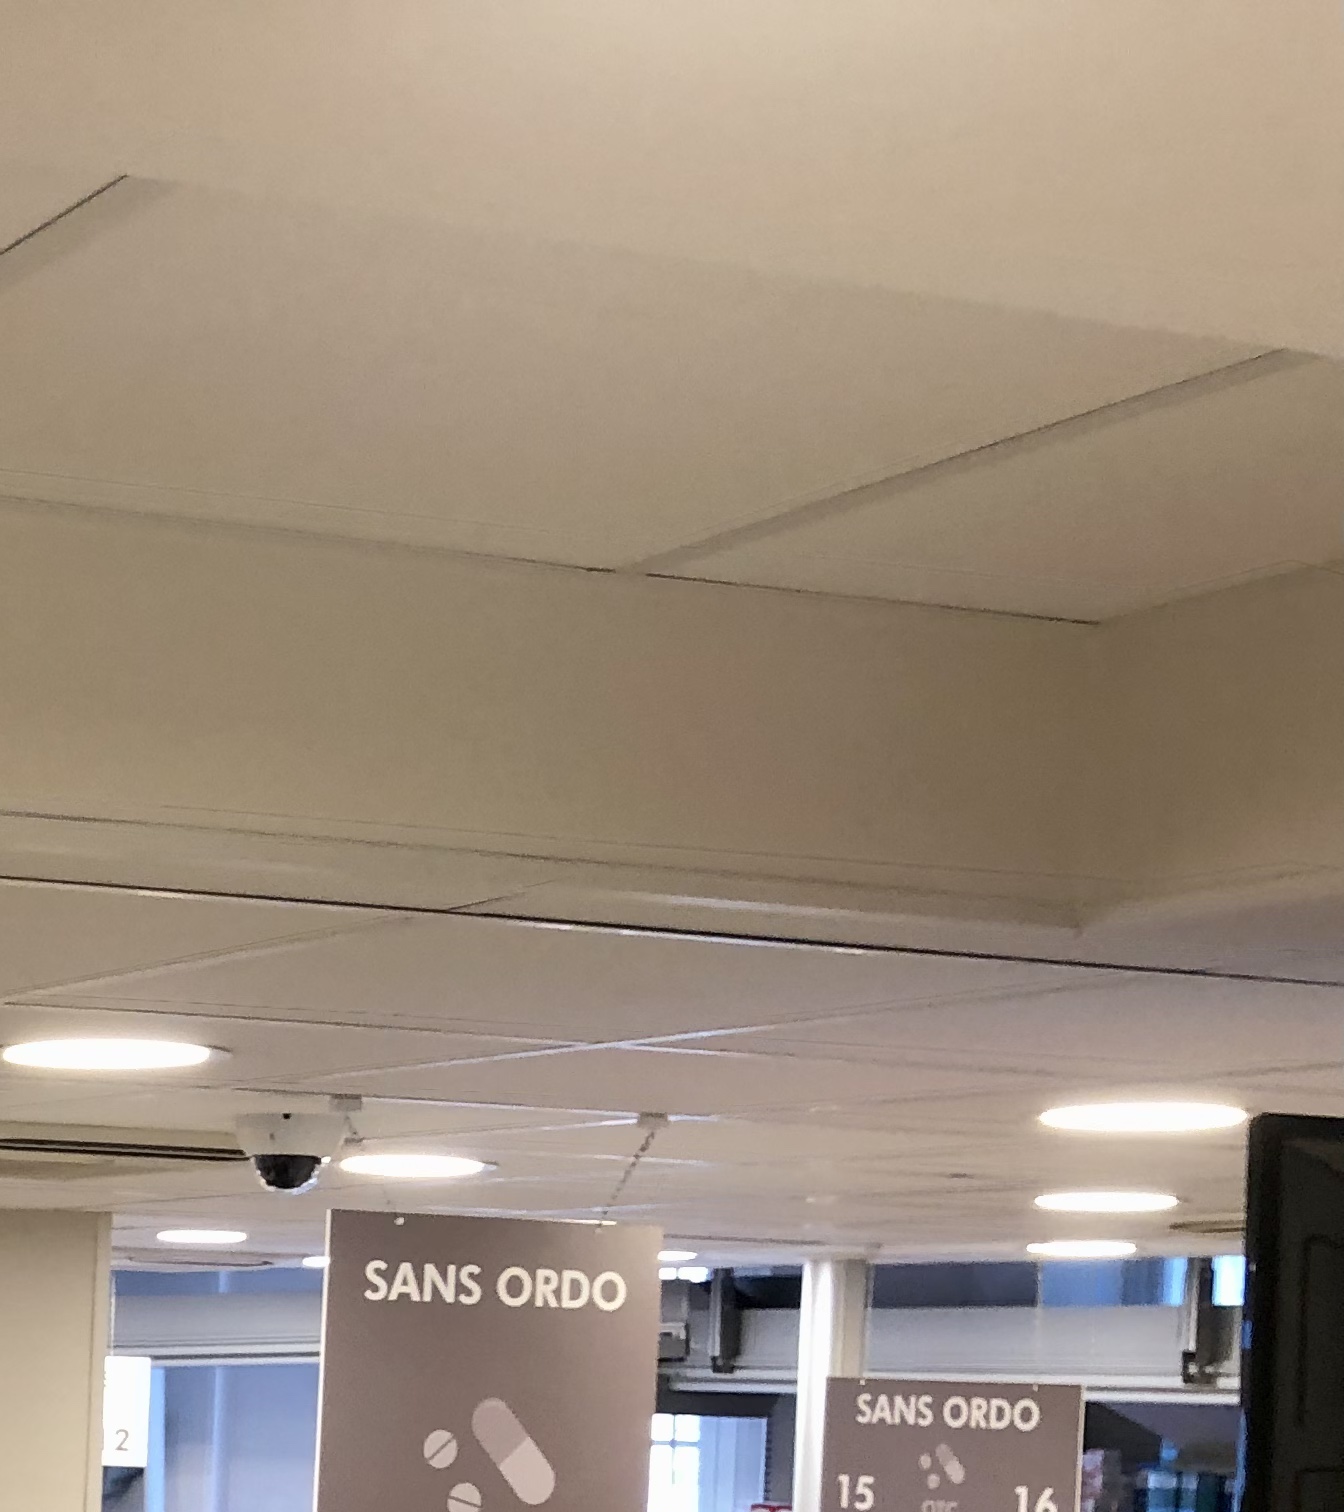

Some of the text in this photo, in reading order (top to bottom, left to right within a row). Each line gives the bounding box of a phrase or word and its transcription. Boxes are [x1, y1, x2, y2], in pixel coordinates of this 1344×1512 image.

[364, 1260, 626, 1312] SANS ORDO
[856, 1393, 1040, 1432] SANS ORDO
[115, 1429, 129, 1451] 2
[838, 1474, 875, 1511] 15
